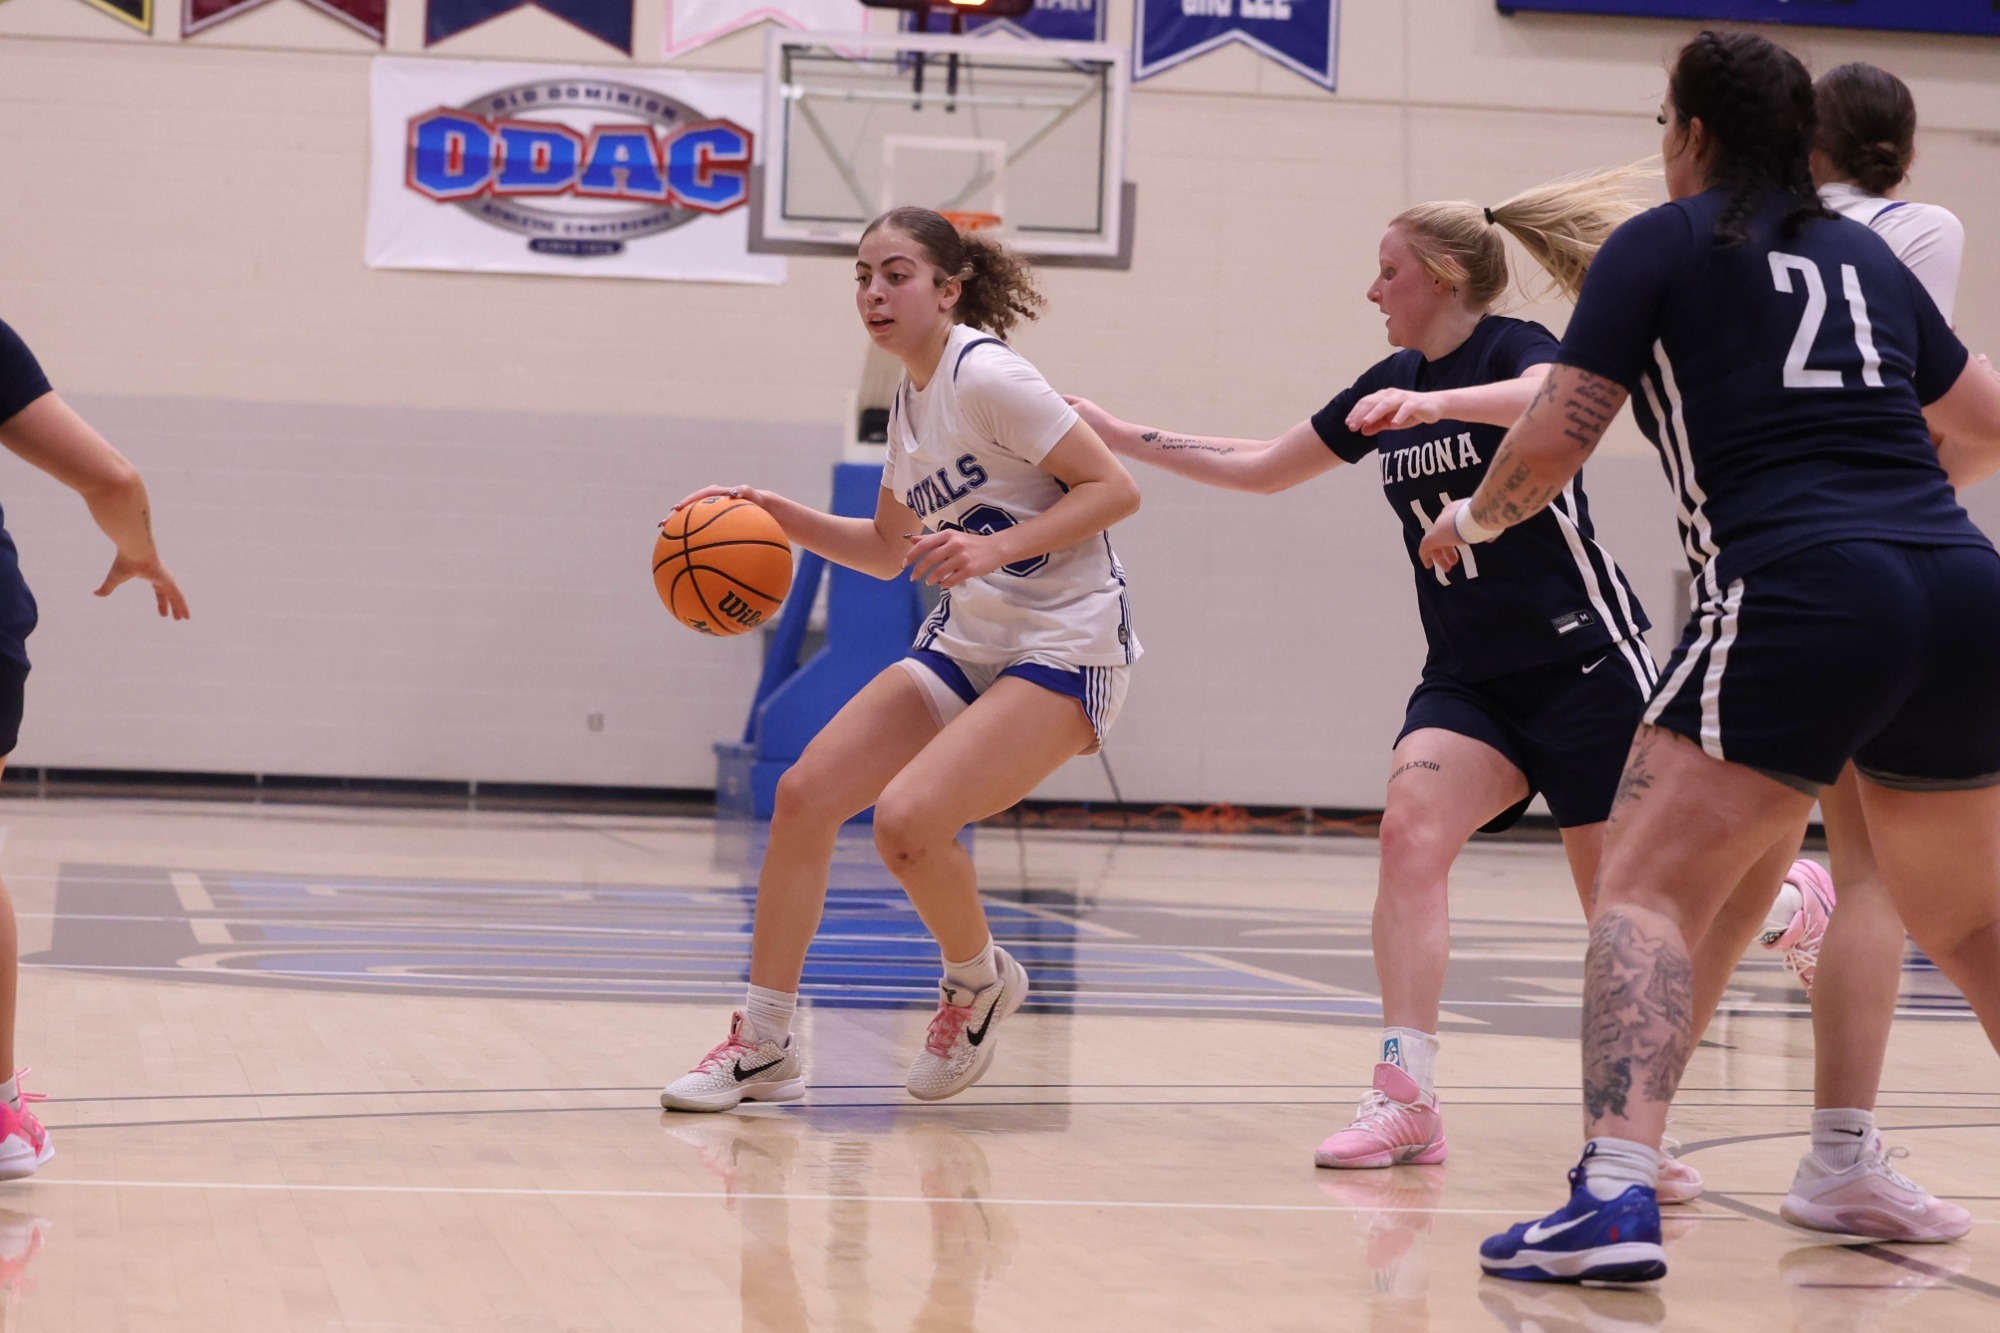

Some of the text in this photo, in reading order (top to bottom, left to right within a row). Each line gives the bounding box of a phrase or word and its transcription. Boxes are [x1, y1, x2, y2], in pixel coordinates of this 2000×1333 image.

[547, 87, 677, 119] DOMINION
[406, 106, 753, 214] ODAC
[1767, 251, 1885, 388] 21
